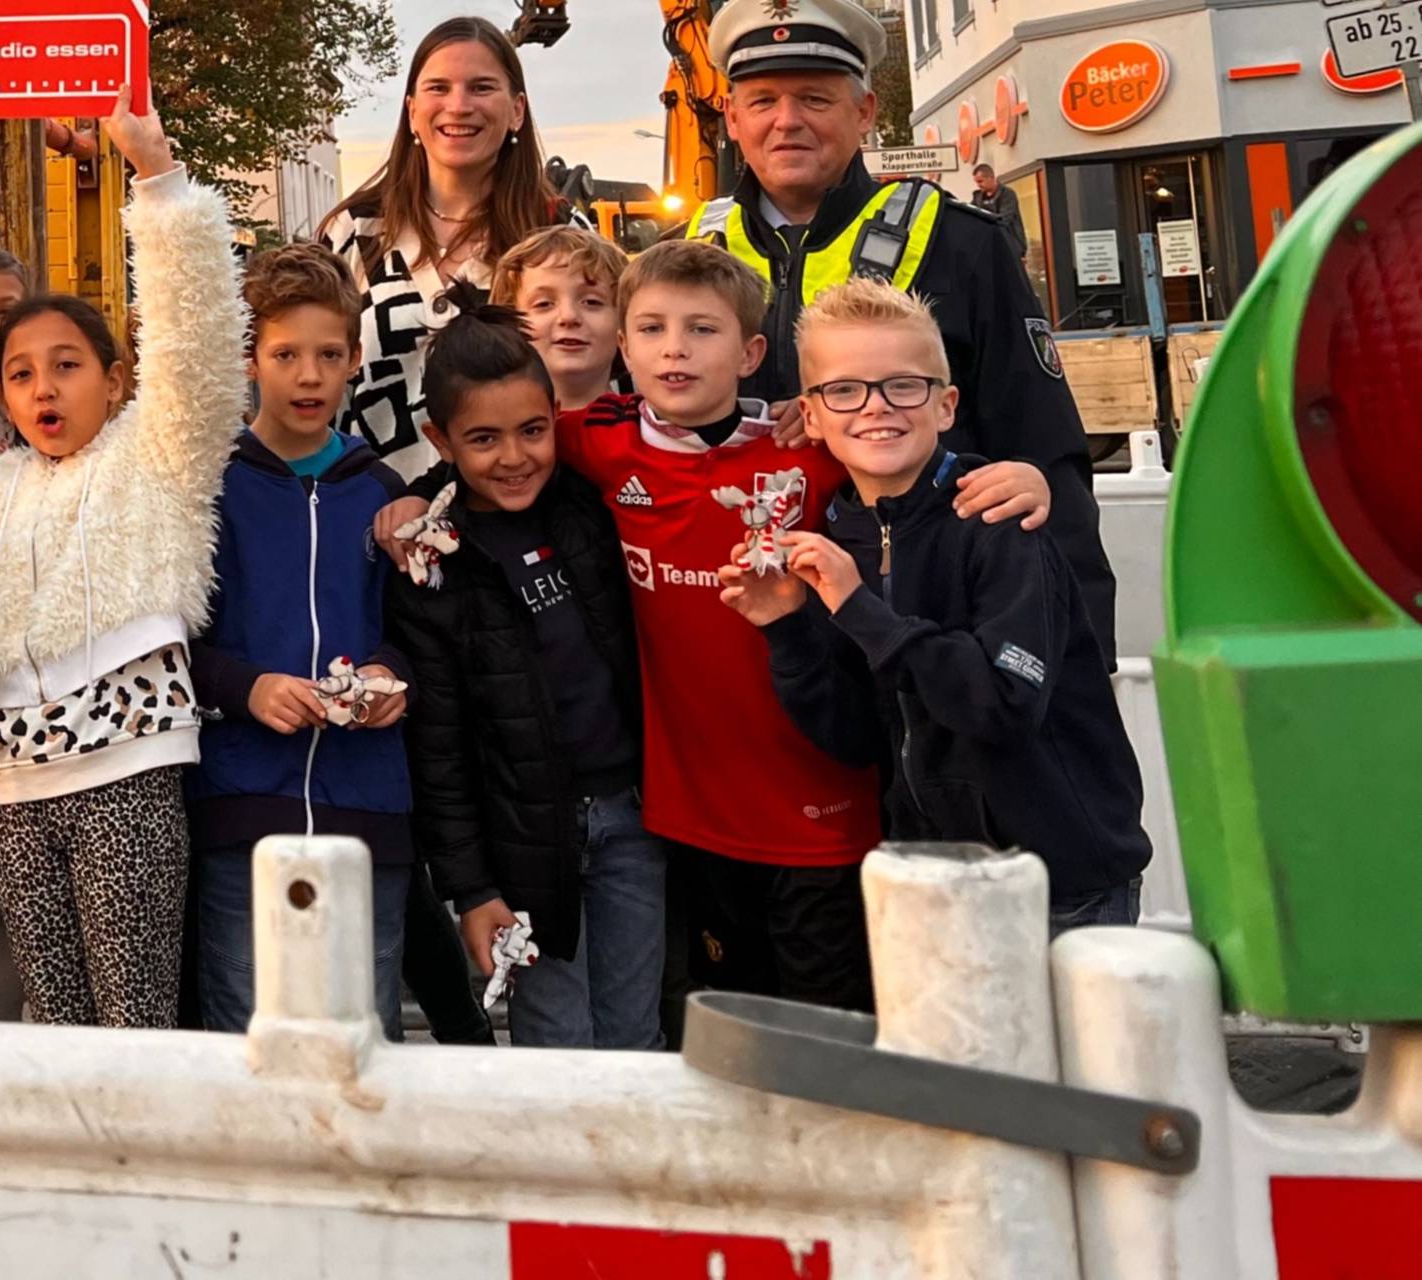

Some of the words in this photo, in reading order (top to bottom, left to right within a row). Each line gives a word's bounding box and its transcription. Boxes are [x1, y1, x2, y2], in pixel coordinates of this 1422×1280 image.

[1345, 17, 1373, 42] ab
[45, 44, 119, 57] essen
[1086, 61, 1151, 85] Bäcker
[1068, 79, 1149, 112] Peter
[881, 150, 936, 163] Sporthalle
[882, 160, 943, 171] Klapperstraße
[616, 494, 653, 506] adidas
[658, 562, 719, 588] Team
